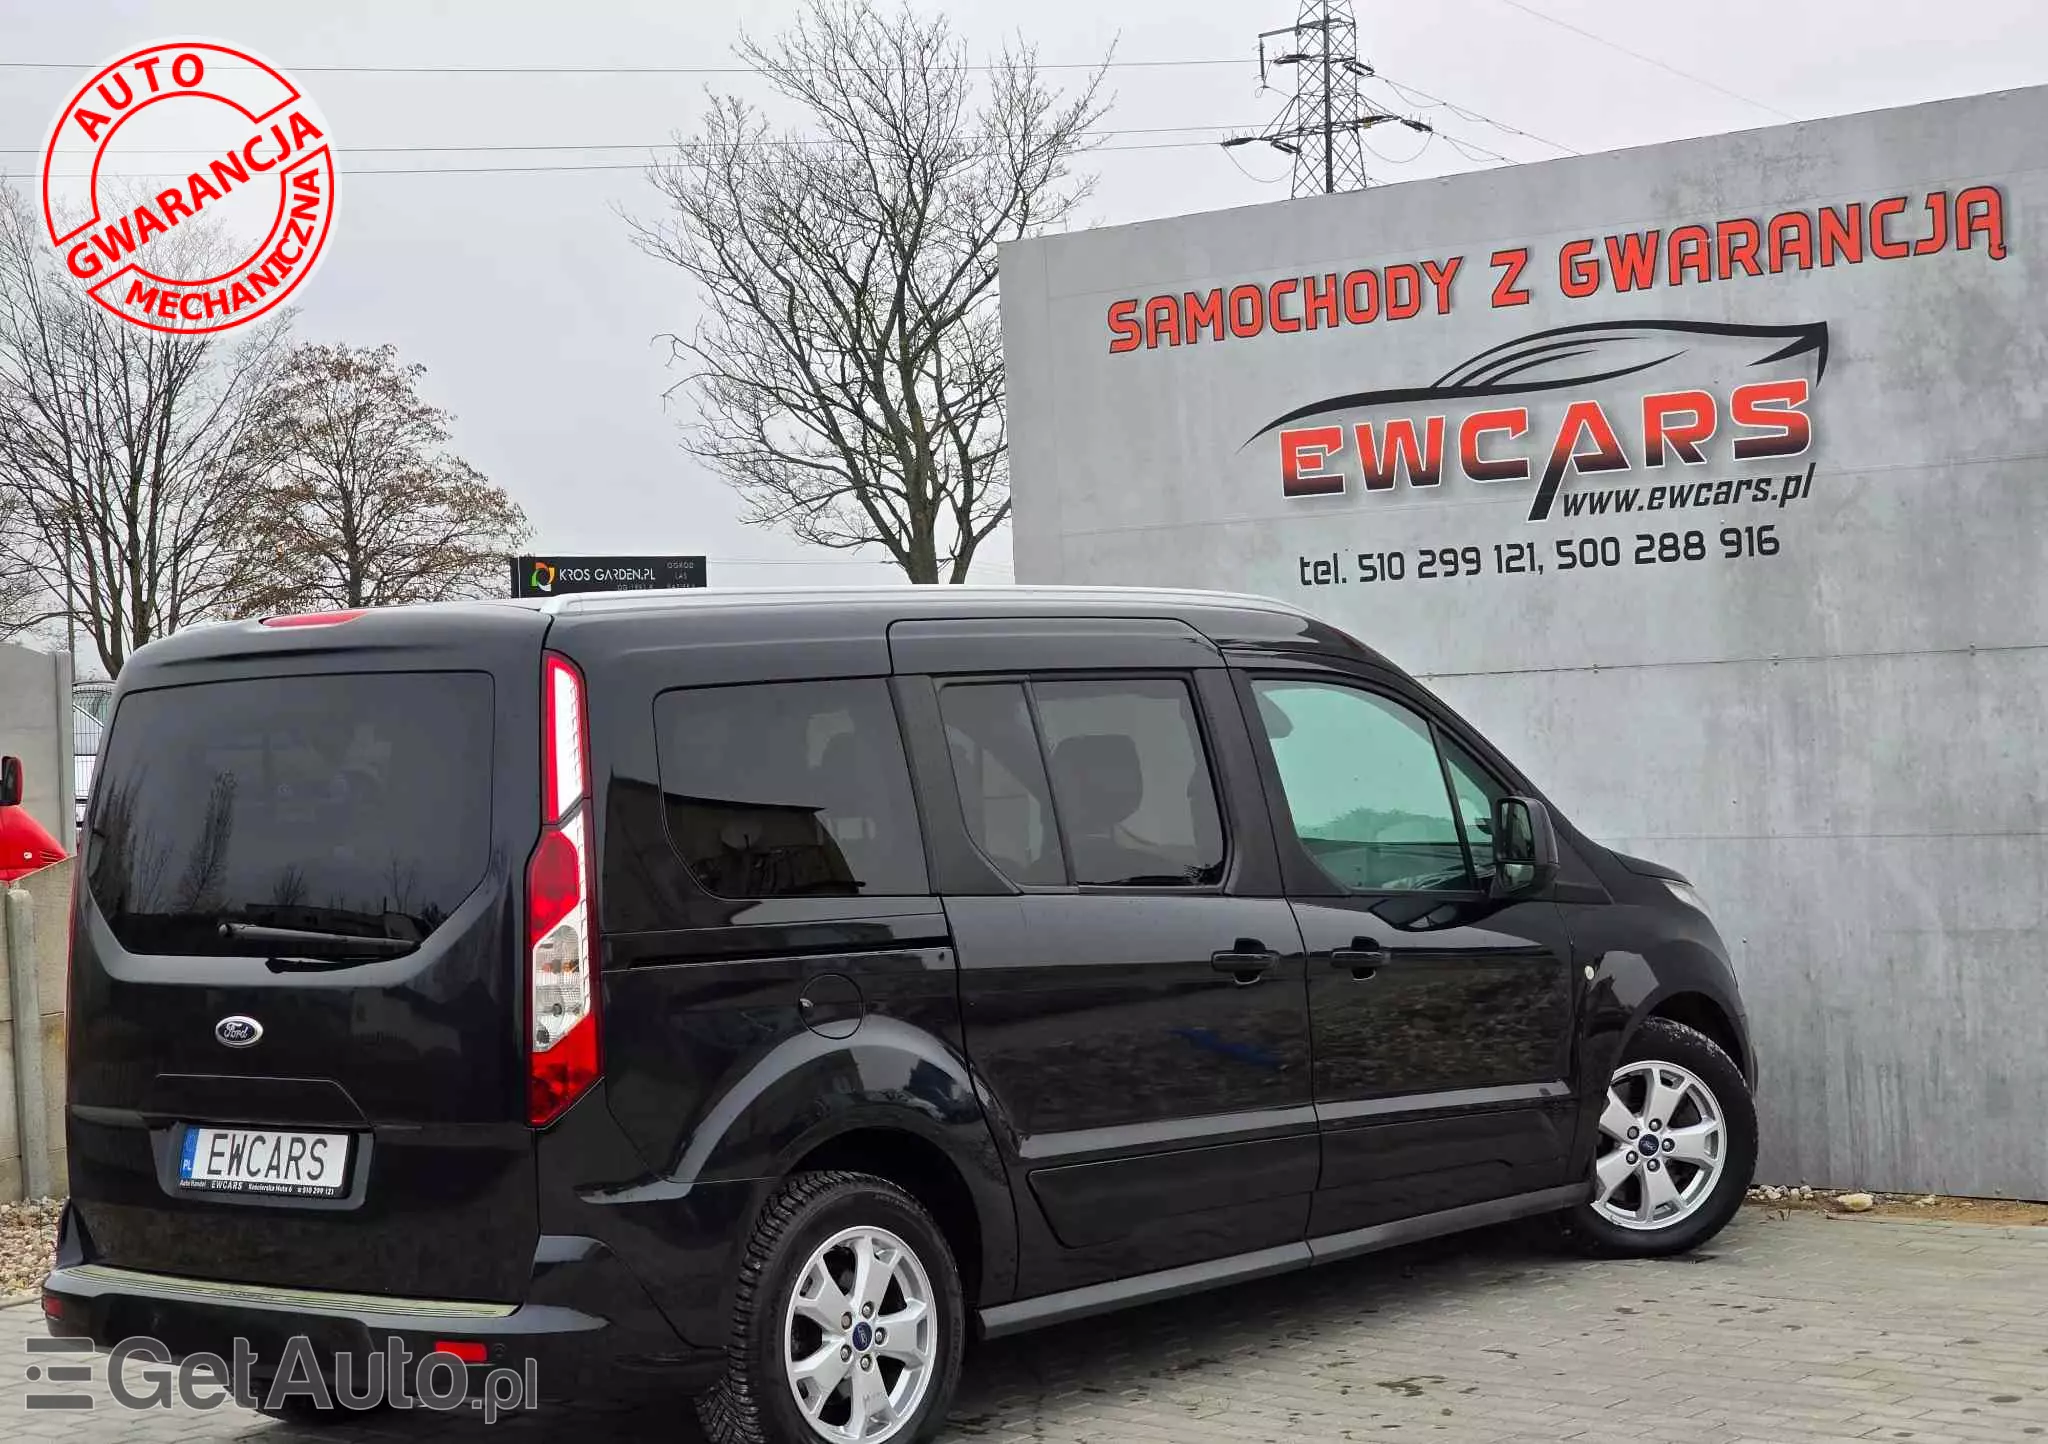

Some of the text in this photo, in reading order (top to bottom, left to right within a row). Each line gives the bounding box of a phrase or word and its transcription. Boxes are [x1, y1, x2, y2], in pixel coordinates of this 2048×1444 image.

[1107, 185, 2007, 354] SAMOCHODY Z GWARANCJĄ
[1279, 378, 1813, 522] EWCARS
[1561, 461, 1817, 518] www.ewcars.pl
[559, 567, 656, 581] KROS GARDEN.PL
[1300, 524, 1781, 586] tel. 510 299 121, 500 288 916
[223, 1021, 249, 1040] Ford
[182, 1159, 193, 1171] PL
[206, 1133, 328, 1181] EWCARS
[211, 1180, 243, 1191] EWCARS
